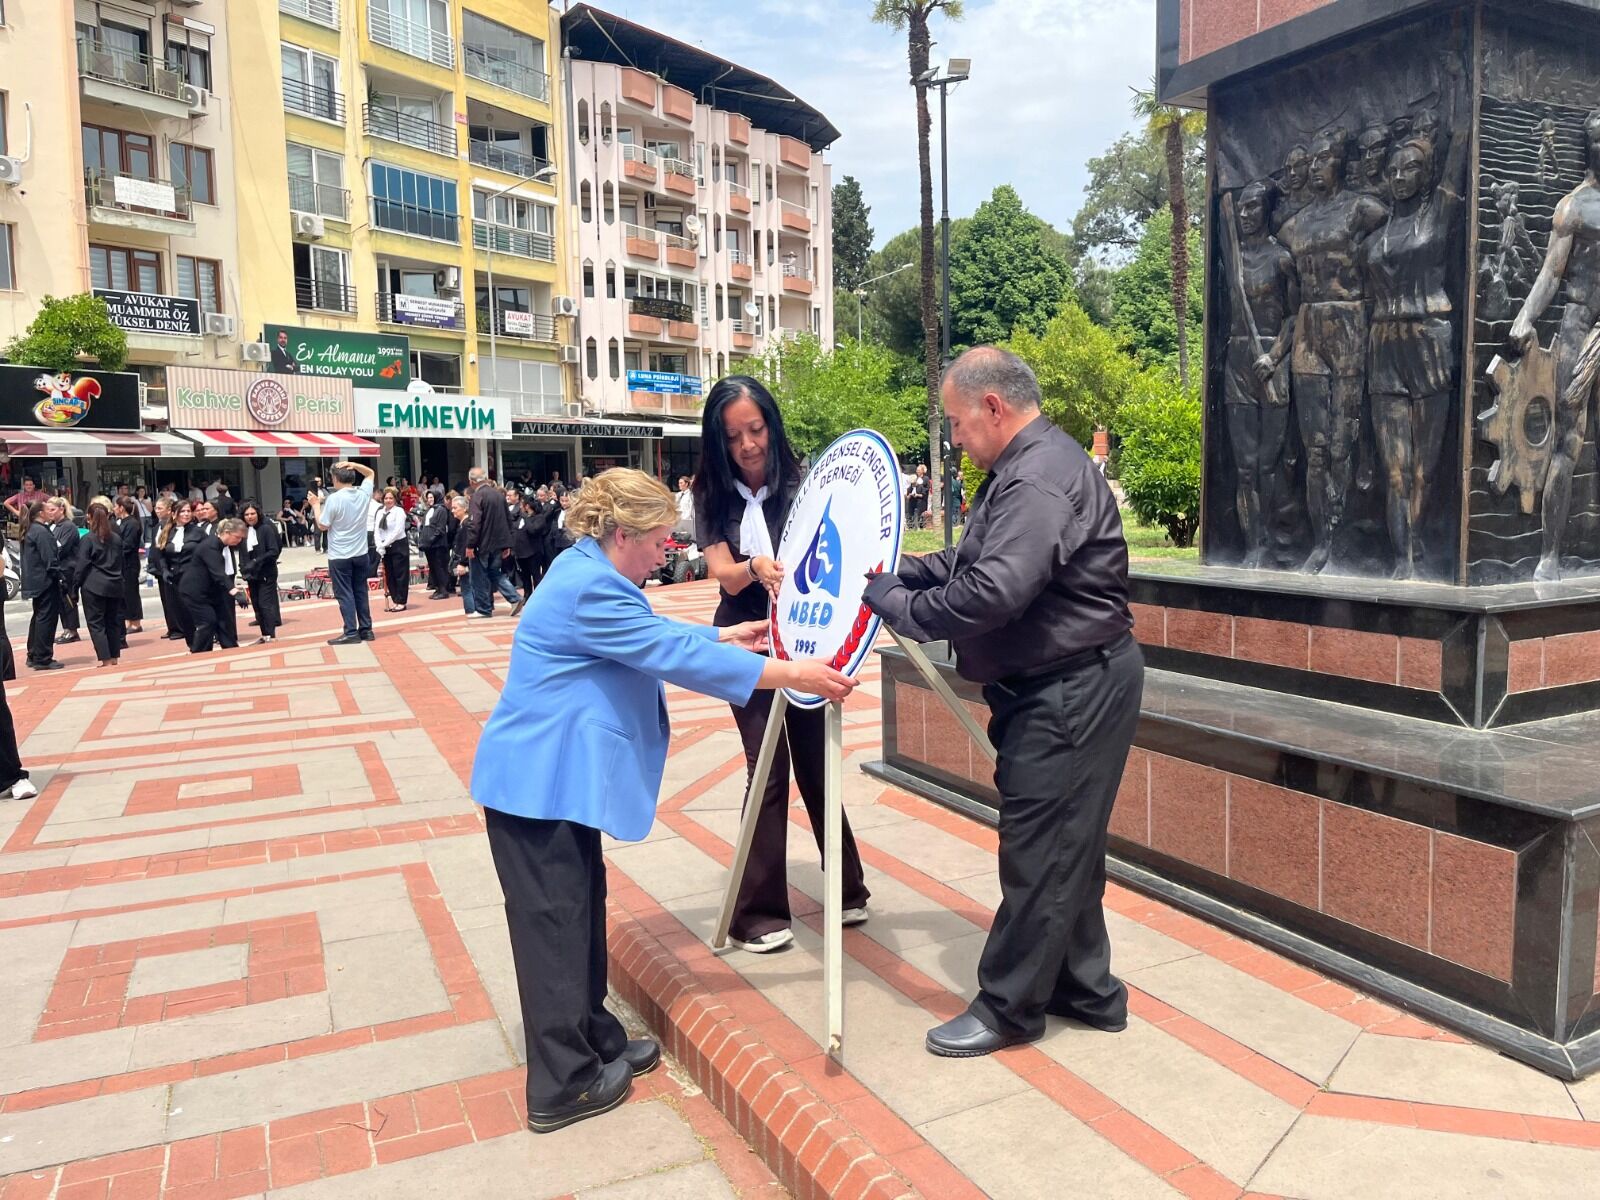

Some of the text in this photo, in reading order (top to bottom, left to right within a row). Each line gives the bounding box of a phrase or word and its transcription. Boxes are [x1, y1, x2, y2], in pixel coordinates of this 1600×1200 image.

[124, 295, 171, 308] AVUKAT
[106, 303, 189, 321] MUAMMER ÖZ
[507, 312, 532, 322] AVUKAT
[156, 319, 191, 332] DENİZ
[295, 342, 377, 366] Ev Almanın
[300, 364, 375, 377] EN KOLAY YOLU
[176, 387, 344, 415] Kahve Perisi
[257, 409, 283, 421] COFFEE
[378, 396, 495, 430] EMİNEVİM
[521, 422, 570, 435] AVUKAT
[570, 424, 612, 436] ORKUN
[614, 426, 654, 437] KIZMAZ
[820, 464, 865, 490] DERNEĞİ
[813, 441, 862, 480] BEDENSEL
[862, 446, 894, 541] ENGELLİLER
[787, 600, 833, 629] NBED
[794, 638, 817, 656] 1995
